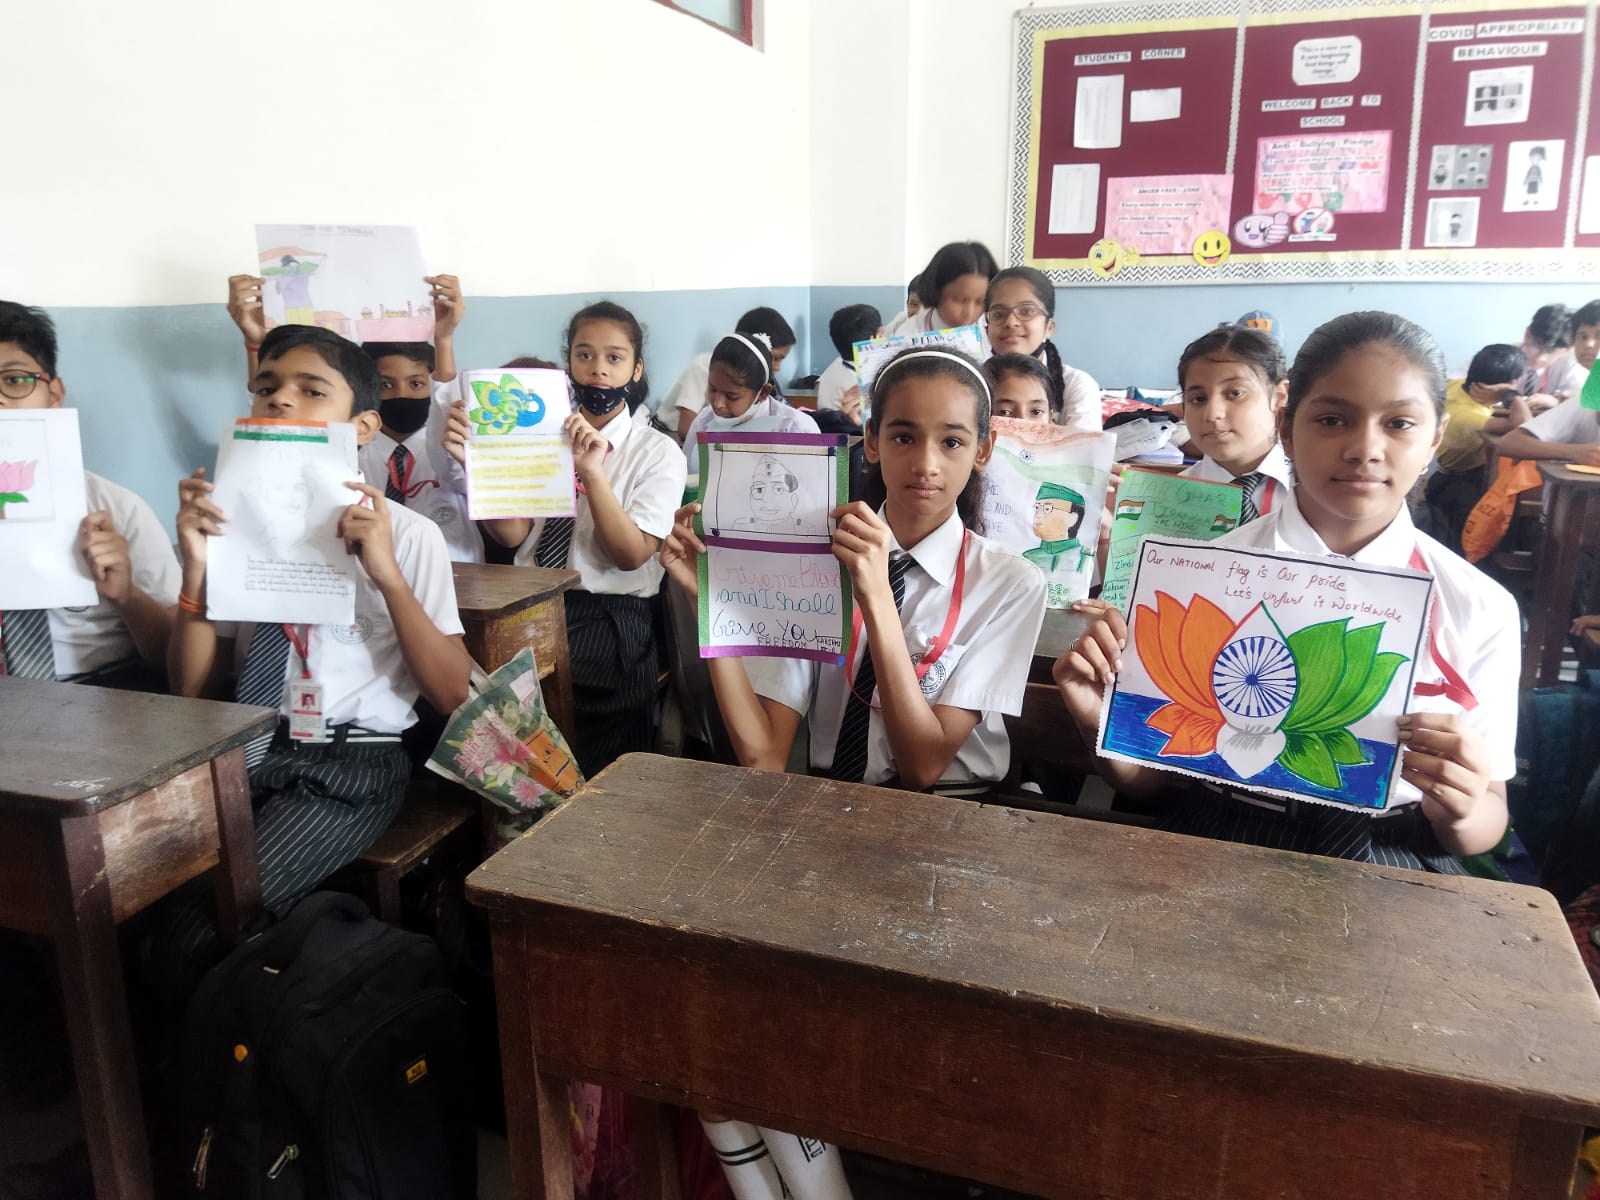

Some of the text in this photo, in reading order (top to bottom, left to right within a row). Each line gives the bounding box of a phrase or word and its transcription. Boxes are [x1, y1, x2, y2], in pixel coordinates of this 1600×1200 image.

[1430, 20, 1577, 40] COVID APPROPRIATE
[1077, 48, 1183, 64] STUDENT'S CORNER
[1457, 44, 1541, 58] BEHAVIOUR
[1264, 95, 1379, 109] WELCOME BACK TO
[1302, 116, 1343, 126] SCHOOL
[1147, 549, 1347, 592] Our NATIONAL flag is Our pride
[759, 588, 774, 609] I
[1224, 586, 1252, 600] Let's
[1314, 594, 1325, 609] it
[713, 608, 770, 638] Give
[757, 636, 807, 649] FREEDOM
